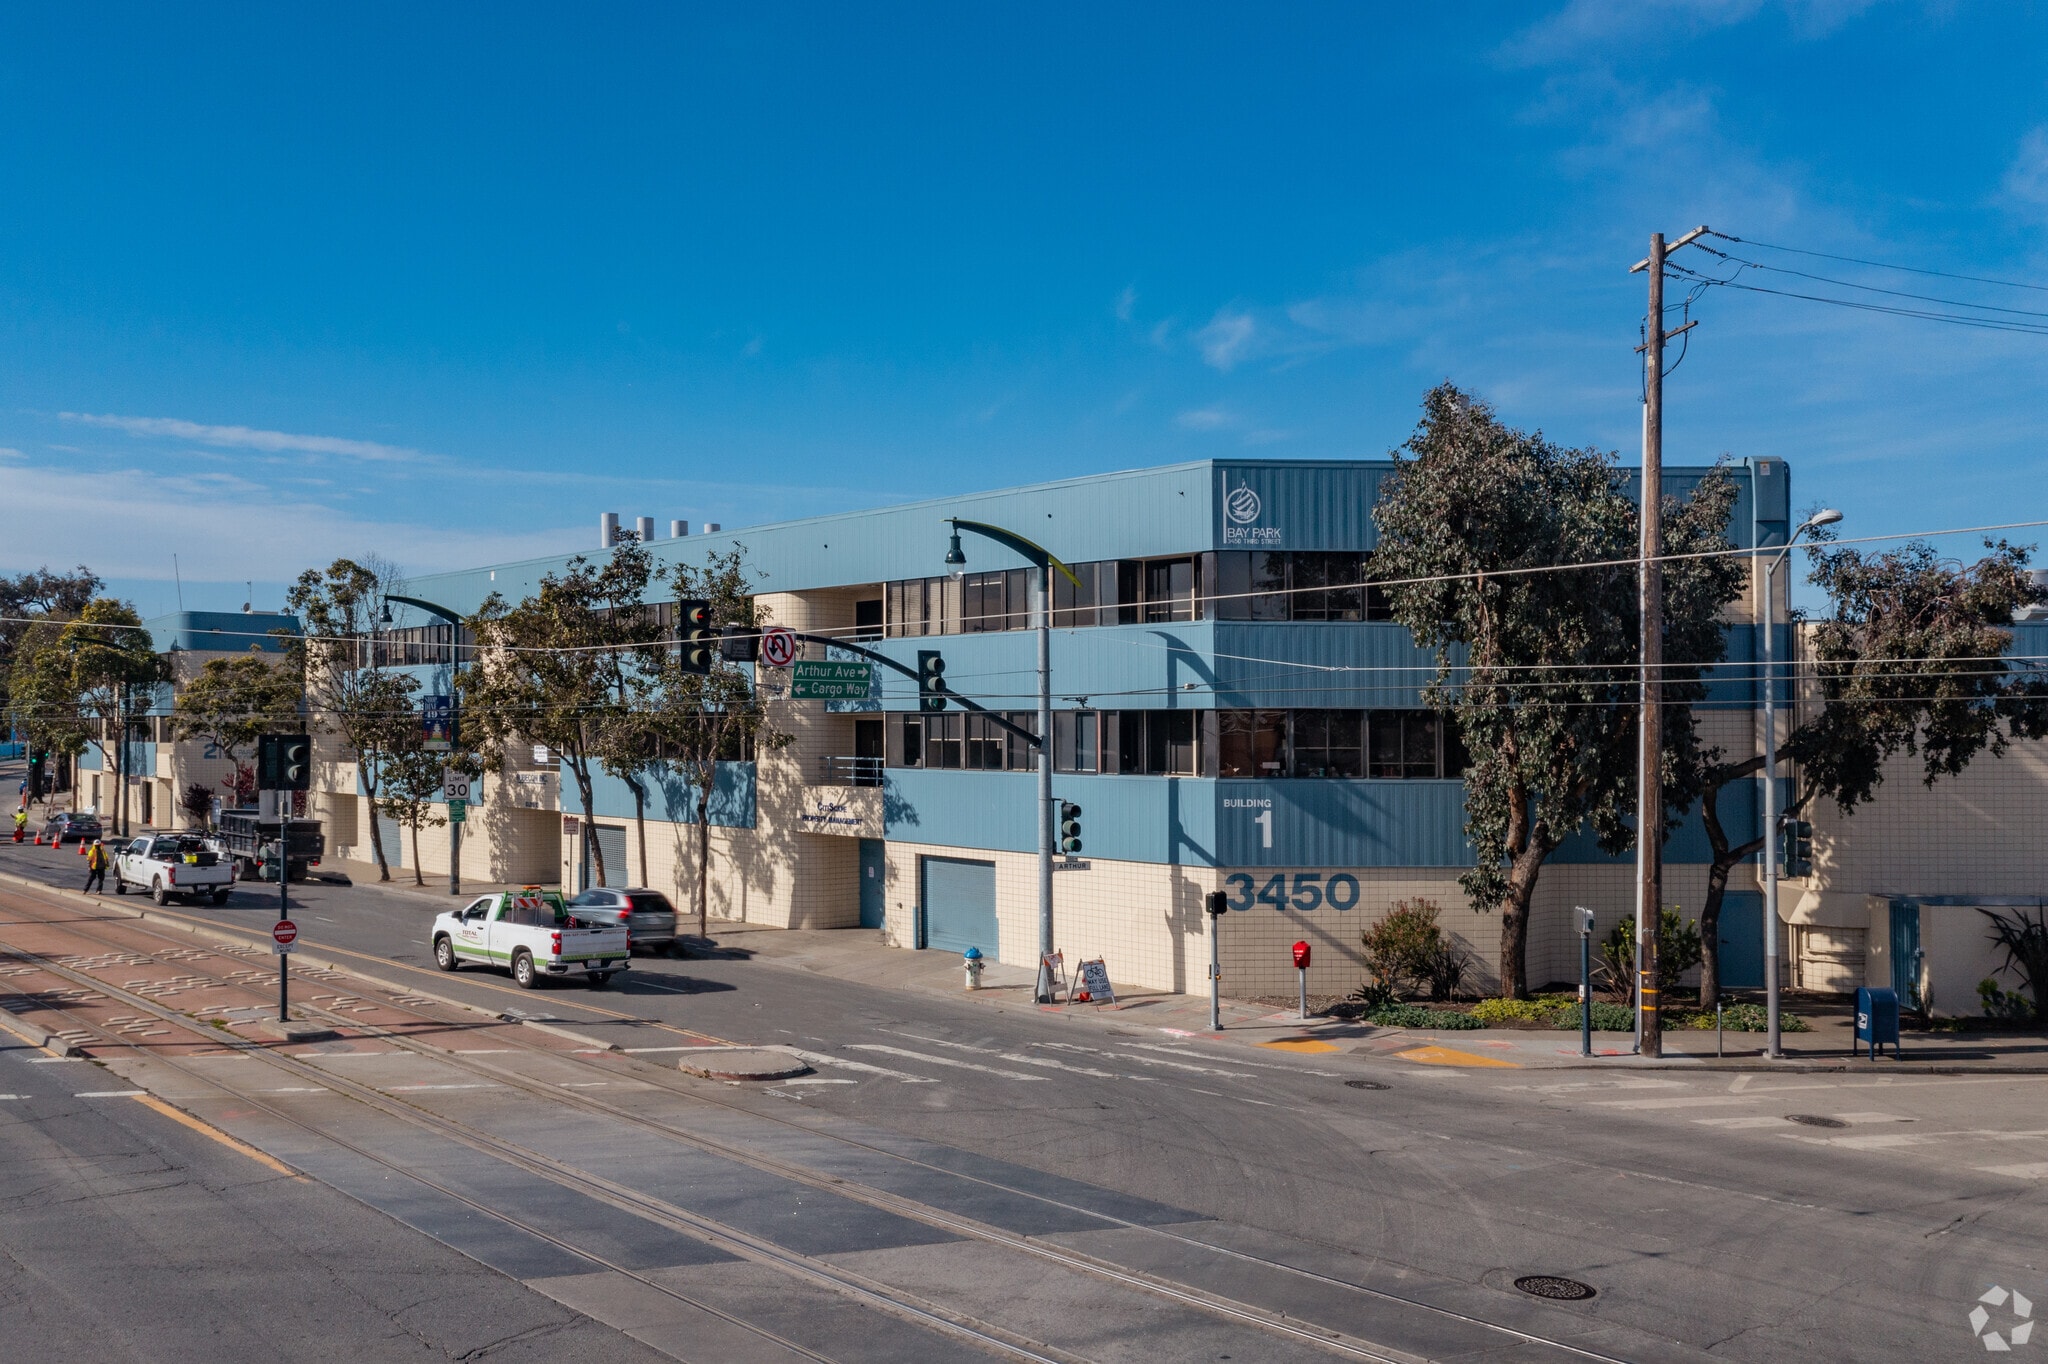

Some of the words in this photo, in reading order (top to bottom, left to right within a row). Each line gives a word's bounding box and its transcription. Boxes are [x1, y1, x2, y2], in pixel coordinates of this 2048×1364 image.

[1227, 527, 1250, 538] BAY
[1252, 527, 1281, 538] PARK
[796, 664, 832, 677] Arthur
[834, 665, 856, 677] Ave
[811, 682, 843, 697] Cargo
[846, 683, 868, 697] Way
[203, 743, 217, 759] 2
[447, 783, 468, 797] 30
[1223, 799, 1272, 808] BUILDING
[1254, 810, 1272, 848] 1
[1225, 872, 1360, 911] 3450
